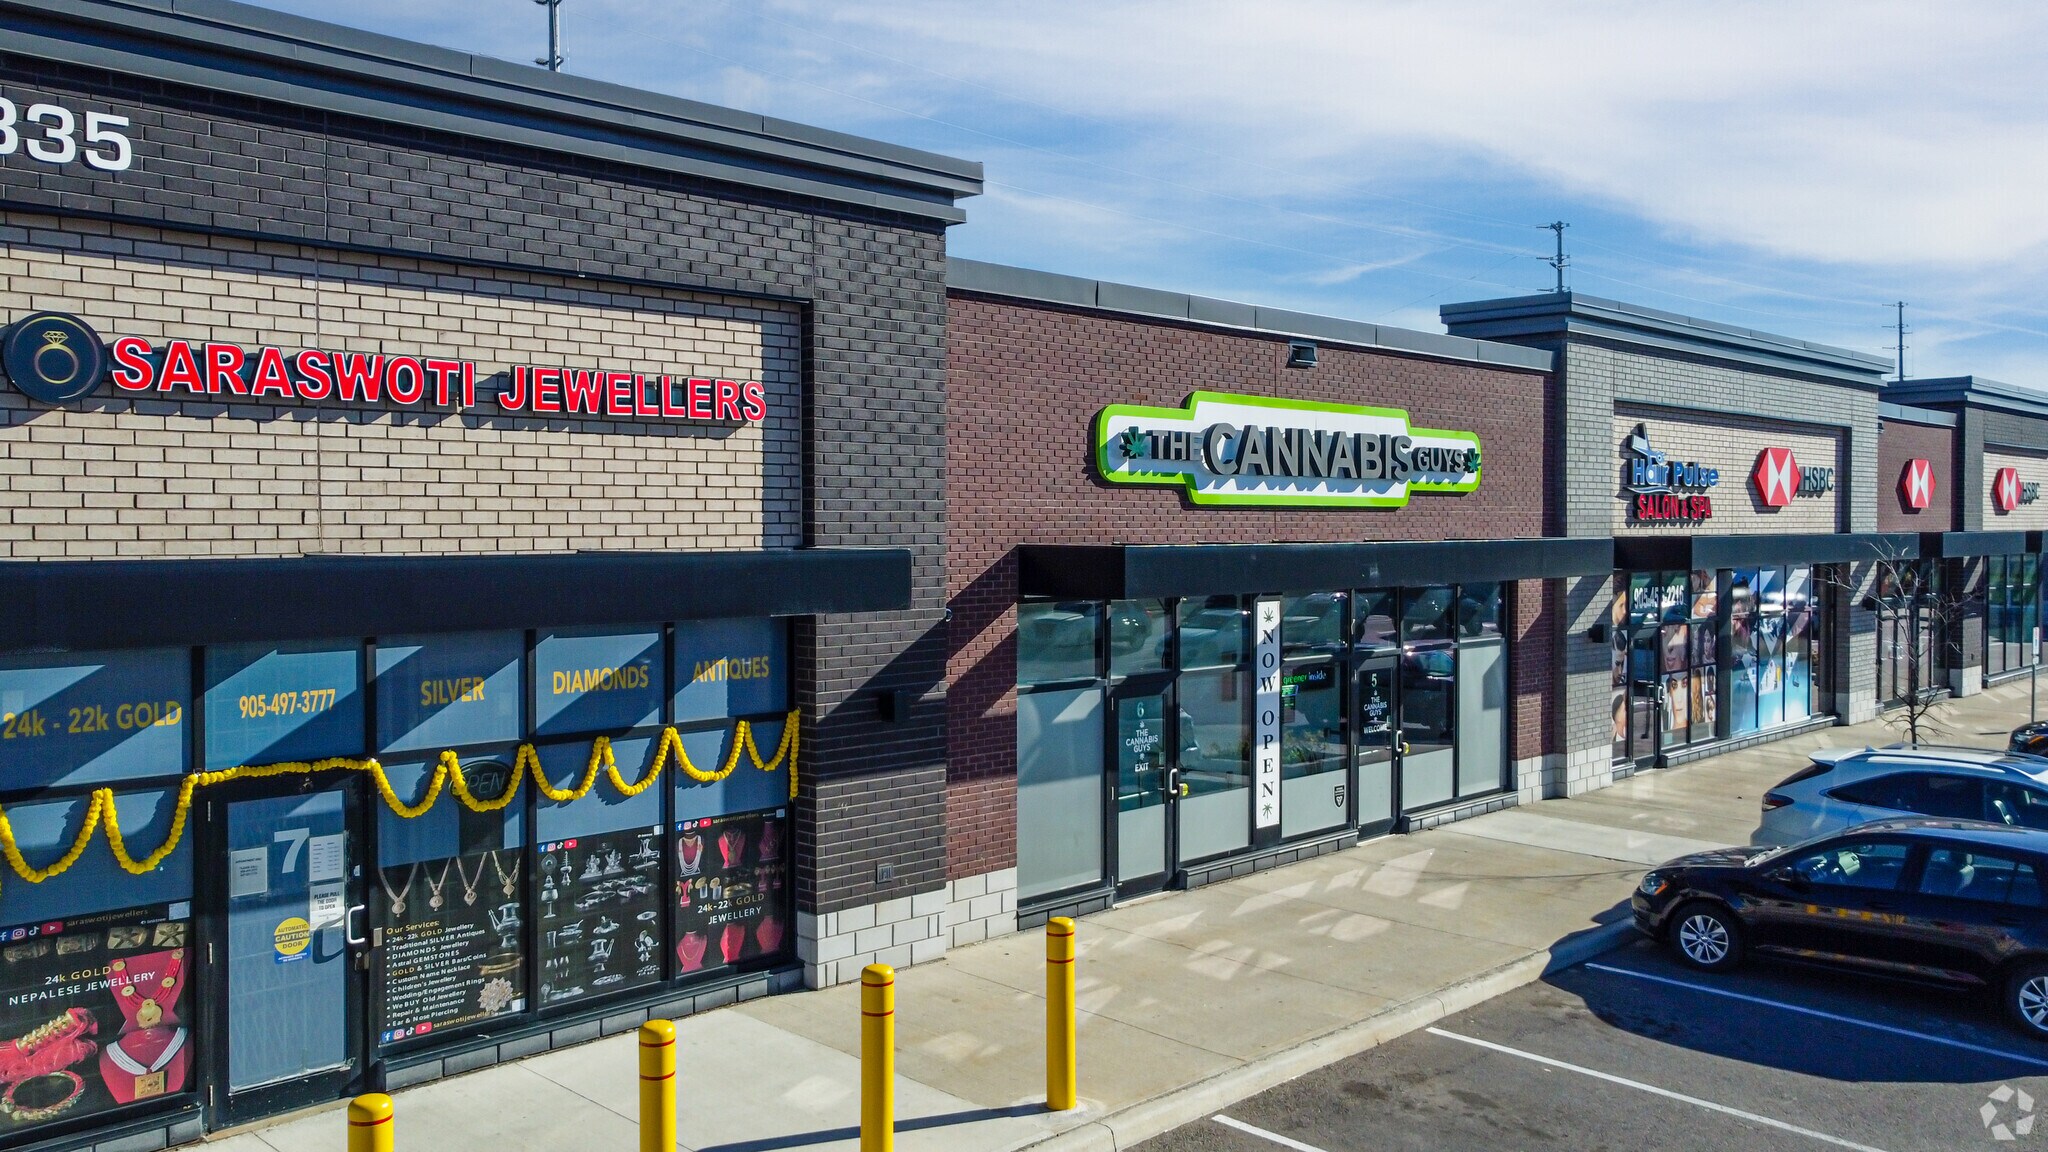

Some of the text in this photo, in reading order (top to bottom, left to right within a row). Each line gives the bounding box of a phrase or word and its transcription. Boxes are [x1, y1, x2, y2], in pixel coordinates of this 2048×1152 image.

[112, 336, 768, 422] SARASWOTI JEWELLERS
[1148, 423, 1465, 481] THE CANNABIS GUYS
[1632, 458, 1719, 487] Hair Pulse
[1801, 466, 1834, 492] HSBC
[1638, 494, 1713, 520] SALON & SPA
[692, 656, 770, 683] ANTIQUES
[552, 665, 649, 695] DIAMONDS
[1371, 673, 1378, 688] 5
[420, 676, 485, 707] SILVER
[1371, 696, 1380, 704] THE
[239, 688, 336, 719] 905-497-3777
[1137, 702, 1145, 718] 6
[1363, 701, 1388, 712] CANNABIS
[3, 711, 46, 739] 24k
[68, 703, 110, 734] 22k
[116, 700, 182, 730] GOLD
[1260, 629, 1276, 799] NOW OPEN
[1136, 729, 1149, 737] THE
[1363, 723, 1388, 734] WELCOME
[1125, 735, 1159, 747] CANNABIS
[1133, 744, 1151, 753] GUYS
[1135, 762, 1149, 772] EXIT
[274, 828, 310, 874] 7
[736, 893, 765, 906] GOLD
[708, 906, 762, 925] JEWELLERY
[275, 931, 310, 942] CAUTION
[278, 923, 308, 933] AUTOMATIC
[386, 919, 440, 935] Our Services:
[420, 928, 443, 938] GOLD
[444, 922, 475, 934] Jewellery
[283, 941, 303, 949] DOOR
[392, 928, 486, 952] Traditional SILVER Antiques
[392, 940, 470, 960] DIAMONDS Jewellery
[392, 949, 460, 969] Astral GEMSTONES
[45, 966, 112, 986] 24k GOLD
[392, 967, 415, 977] GOLD
[424, 959, 450, 970] SILVER
[392, 964, 471, 985] Custom Name Necklace
[9, 971, 156, 1006] NEPALESE JEWELLERY
[392, 975, 457, 993] Children's Jewellery
[466, 976, 485, 987] Rings
[404, 999, 420, 1008] BUY
[422, 994, 435, 1004] Old
[436, 989, 467, 1001] Jewellery
[392, 1010, 414, 1020] Repair
[422, 998, 465, 1012] Maintenance
[392, 1019, 404, 1028] Ear
[412, 1013, 430, 1022] Nose
[431, 1007, 459, 1019] Piercing
